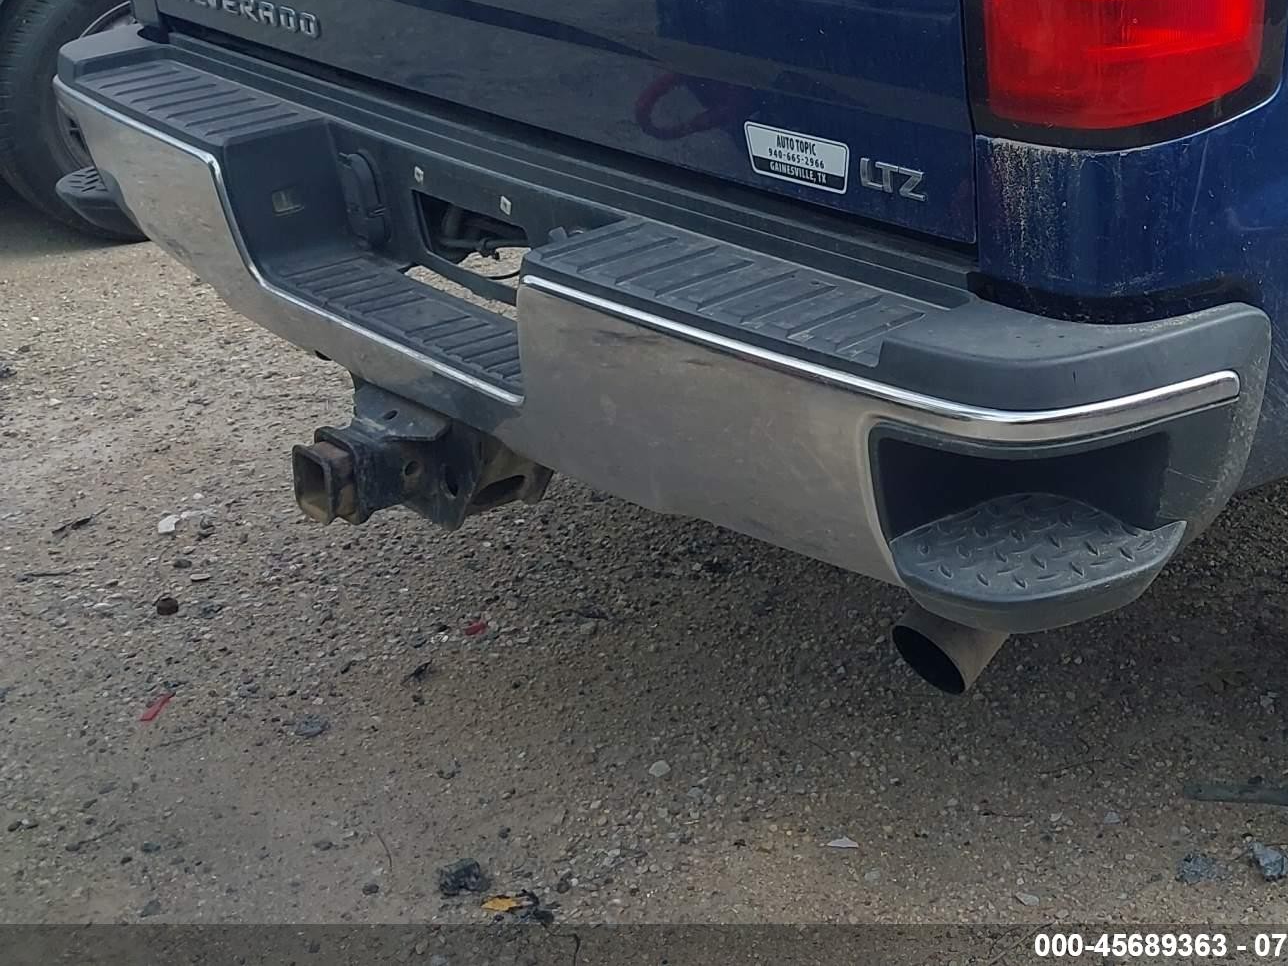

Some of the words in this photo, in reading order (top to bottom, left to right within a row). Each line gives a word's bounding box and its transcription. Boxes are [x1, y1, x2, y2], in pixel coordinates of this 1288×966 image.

[776, 134, 795, 151] AUTO
[795, 139, 817, 156] TOPIC
[768, 147, 825, 170] 940-665-2966
[769, 161, 817, 184] GAINESVILLE,
[817, 172, 827, 184] TX
[859, 157, 927, 201] LTZ
